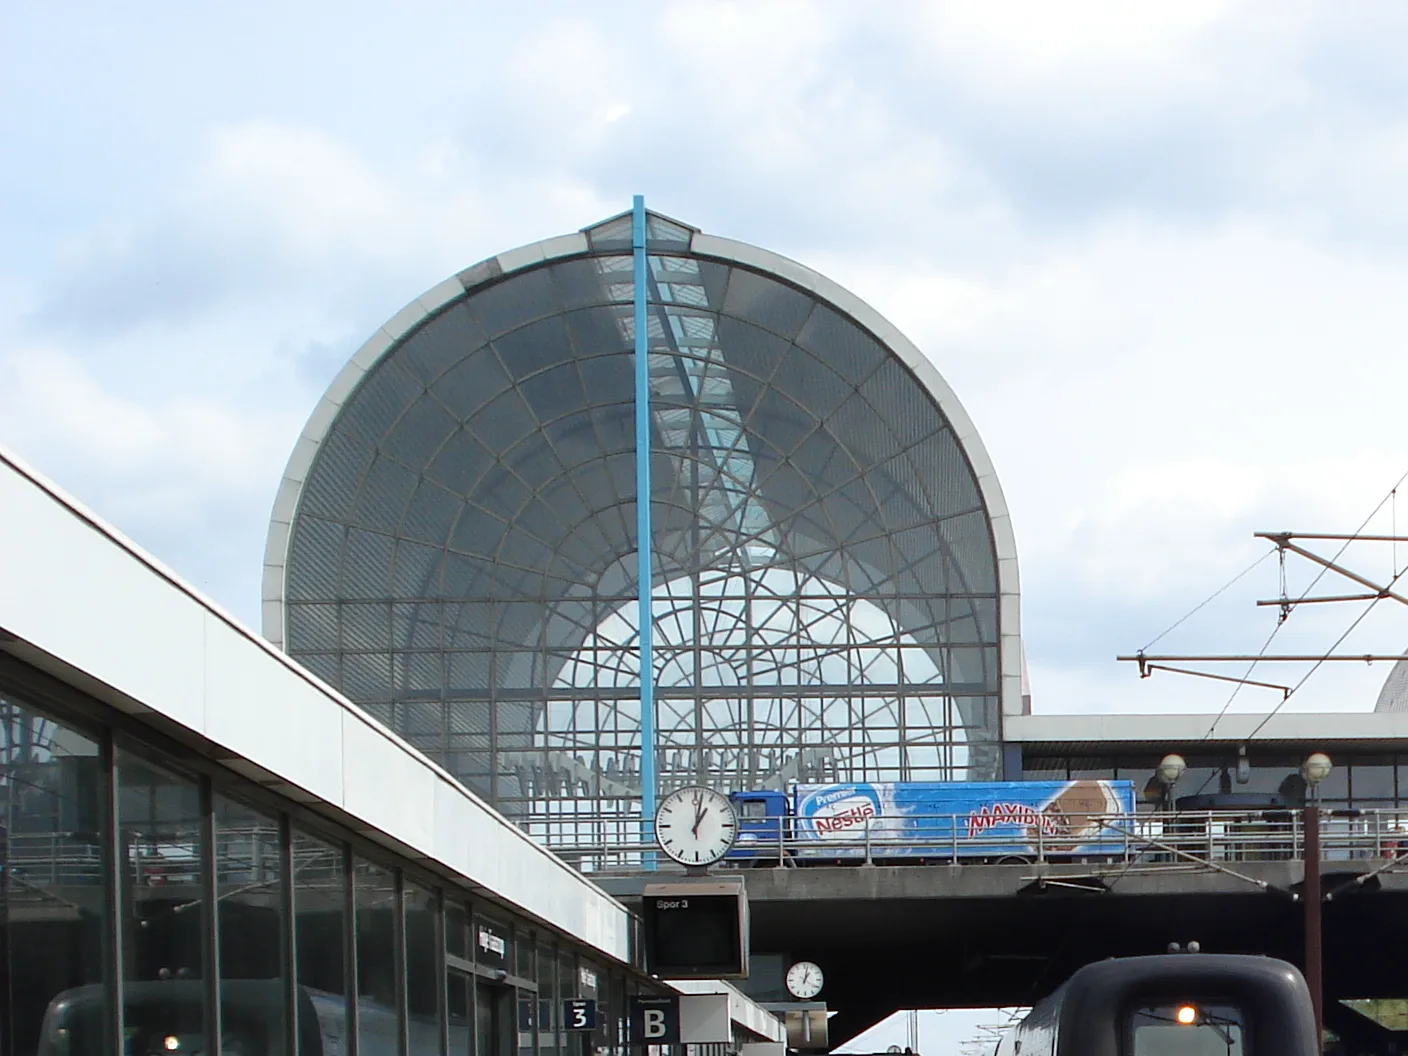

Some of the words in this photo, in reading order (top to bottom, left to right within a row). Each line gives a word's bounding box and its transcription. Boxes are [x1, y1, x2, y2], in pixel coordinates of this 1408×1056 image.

[656, 900, 680, 909] Spor
[681, 900, 688, 908] 3
[573, 1009, 587, 1028] 3
[643, 1009, 666, 1038] B
